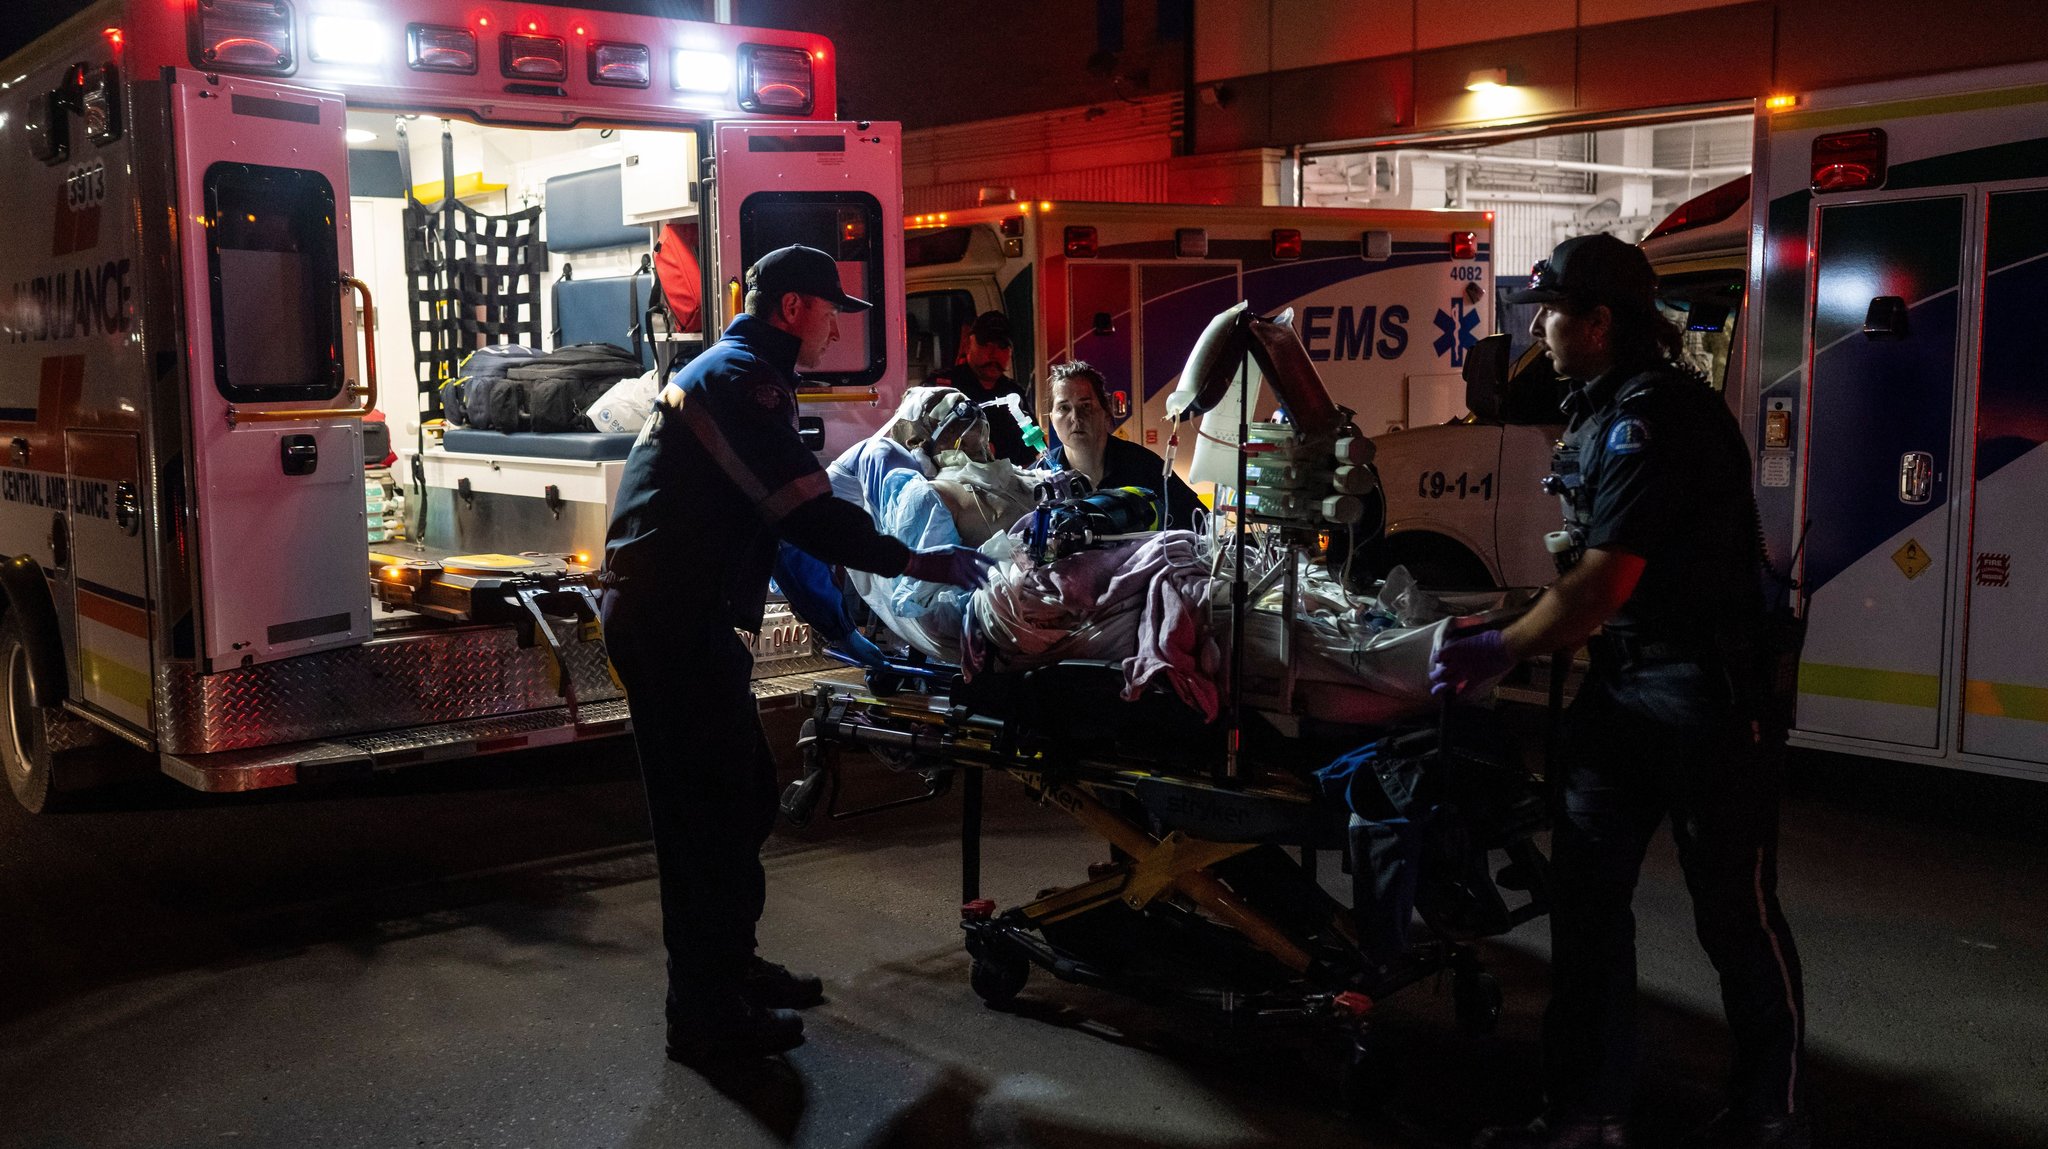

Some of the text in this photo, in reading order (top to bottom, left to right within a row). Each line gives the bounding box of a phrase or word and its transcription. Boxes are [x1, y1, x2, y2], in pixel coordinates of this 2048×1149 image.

[1450, 266, 1482, 281] 4082
[1302, 305, 1410, 361] EMS
[2, 470, 110, 519] CENTRAL AMBLANCE
